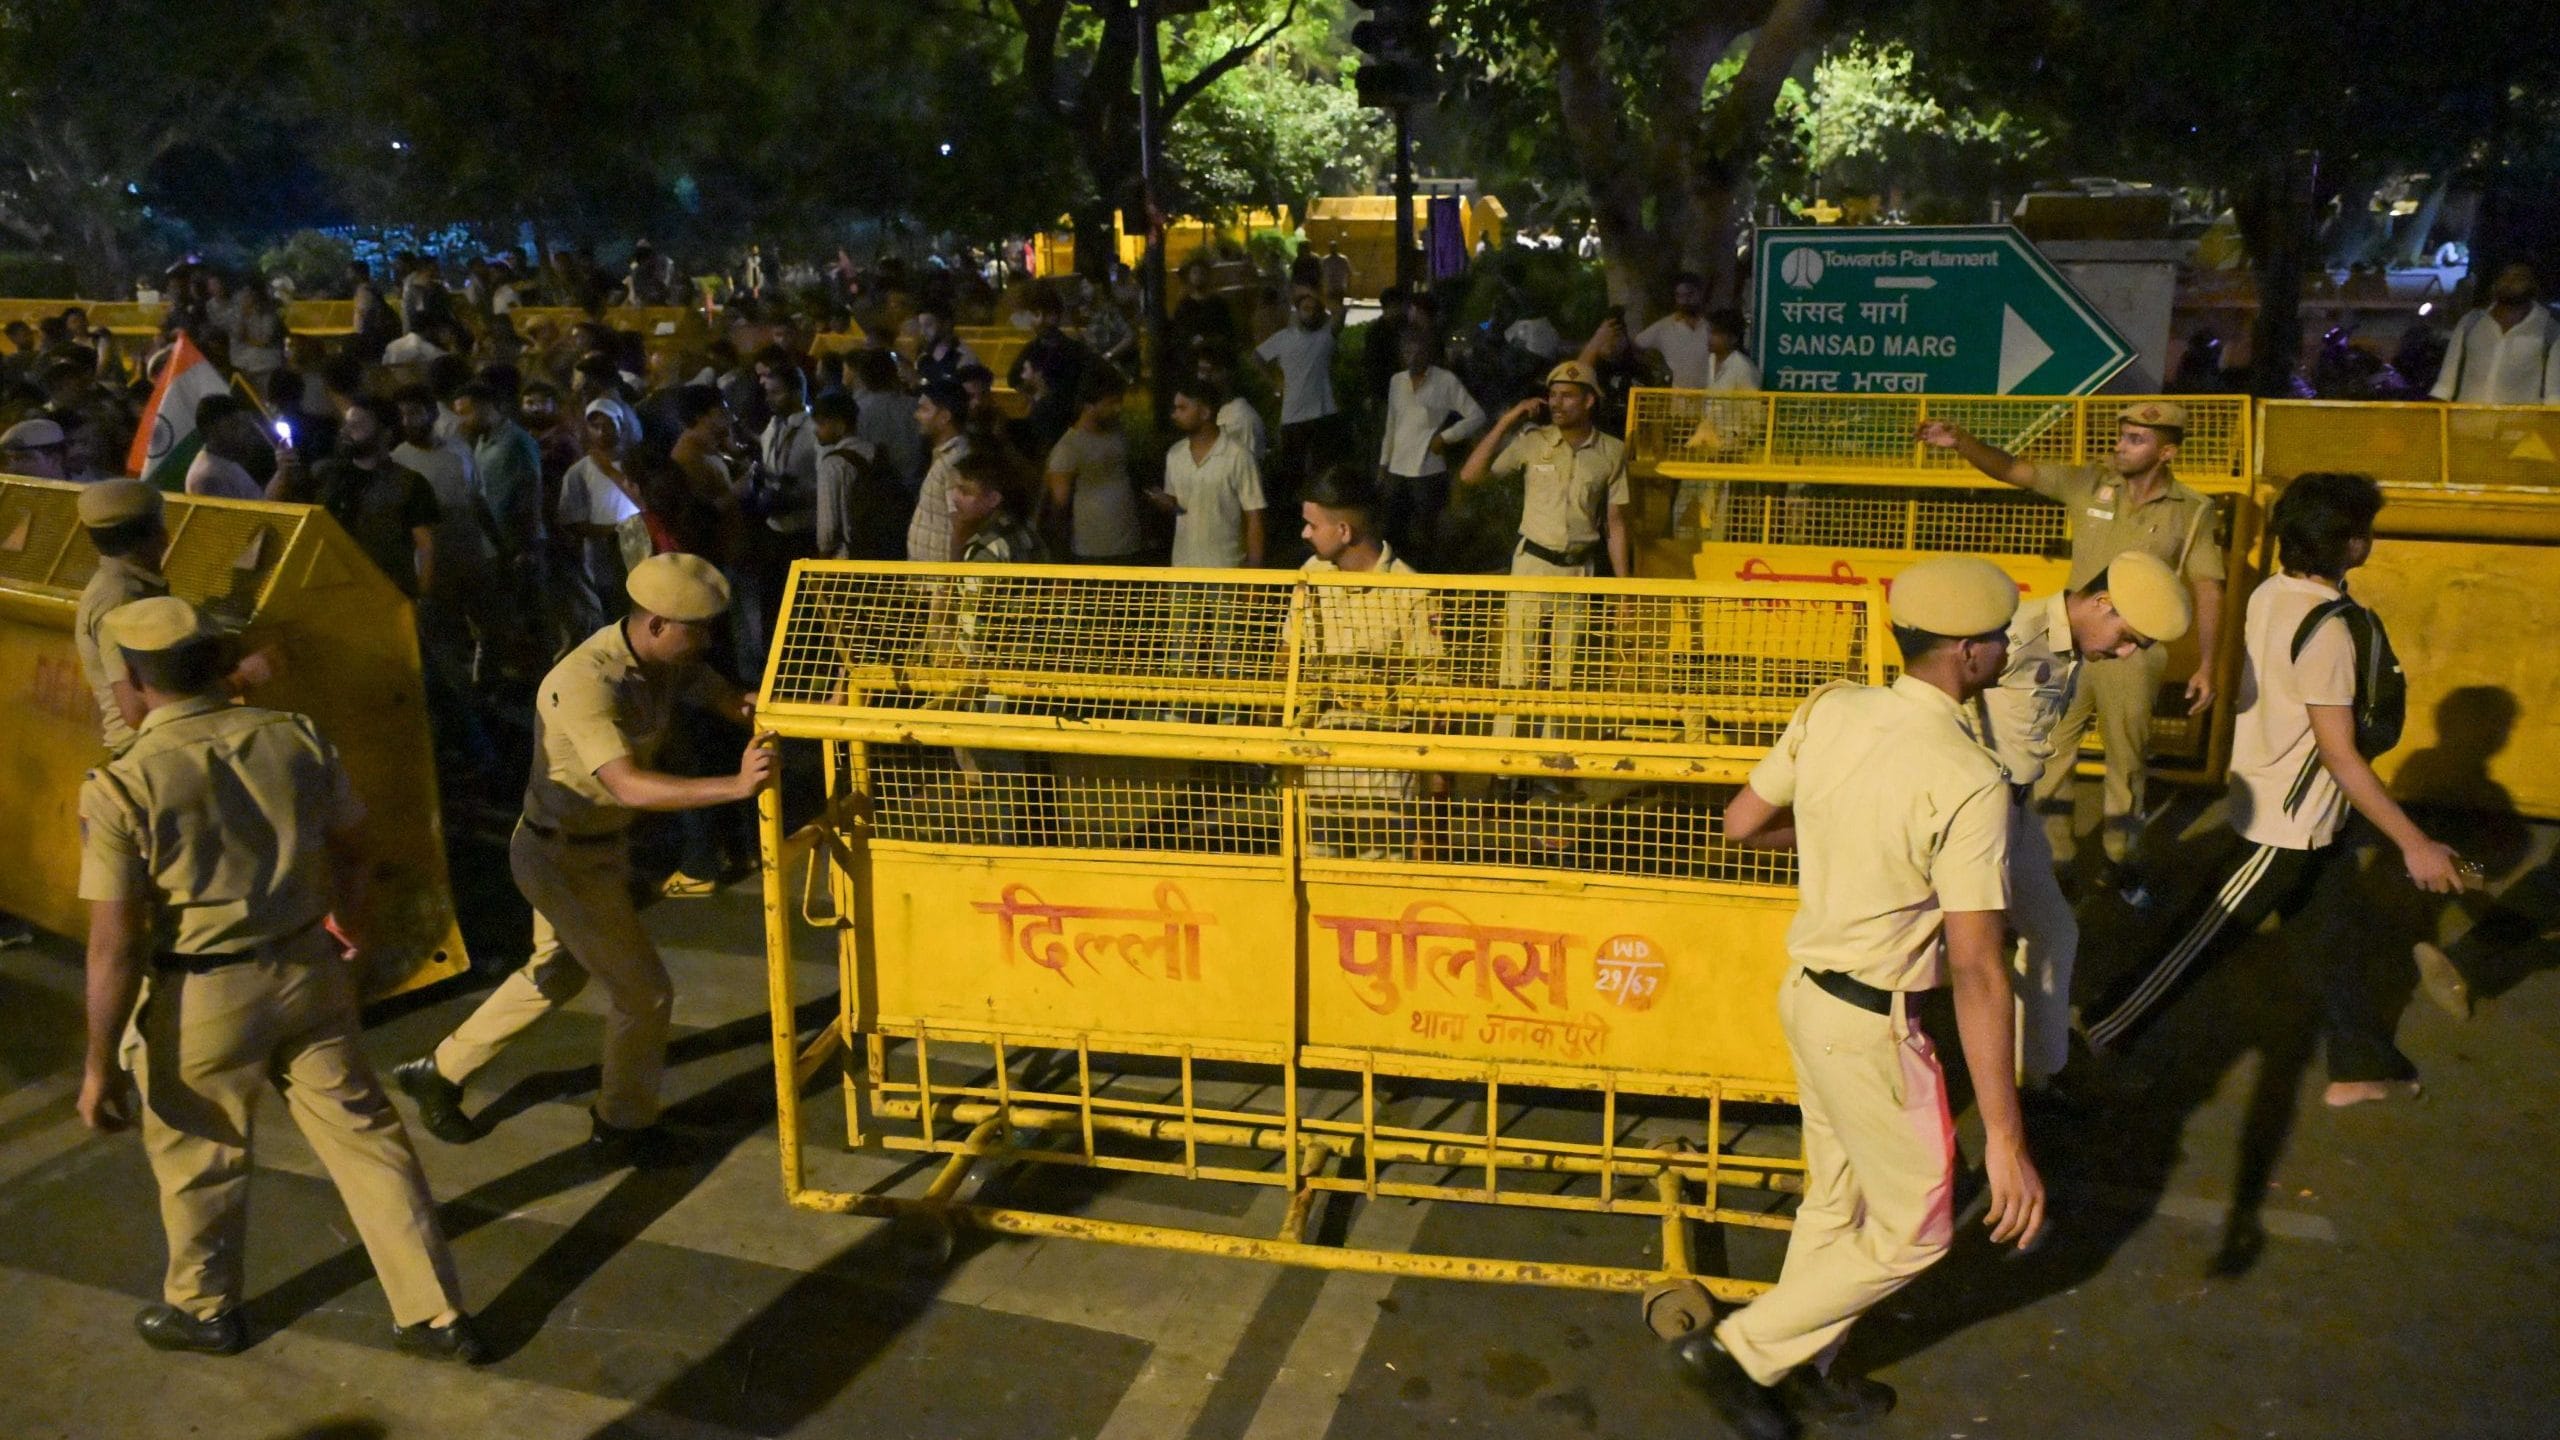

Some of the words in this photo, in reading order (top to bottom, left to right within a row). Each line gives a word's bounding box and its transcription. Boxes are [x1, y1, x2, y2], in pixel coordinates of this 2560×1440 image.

[1822, 250, 1896, 267] Towards
[1900, 250, 2000, 267] Parliament
[1779, 296, 1847, 325] संसद
[1859, 294, 1909, 325] मार्ग
[1778, 334, 1876, 356] SANSAD
[1883, 335, 1957, 358] MARG
[969, 879, 1218, 988] दिल्ली
[1313, 901, 1590, 1016] पुलिस
